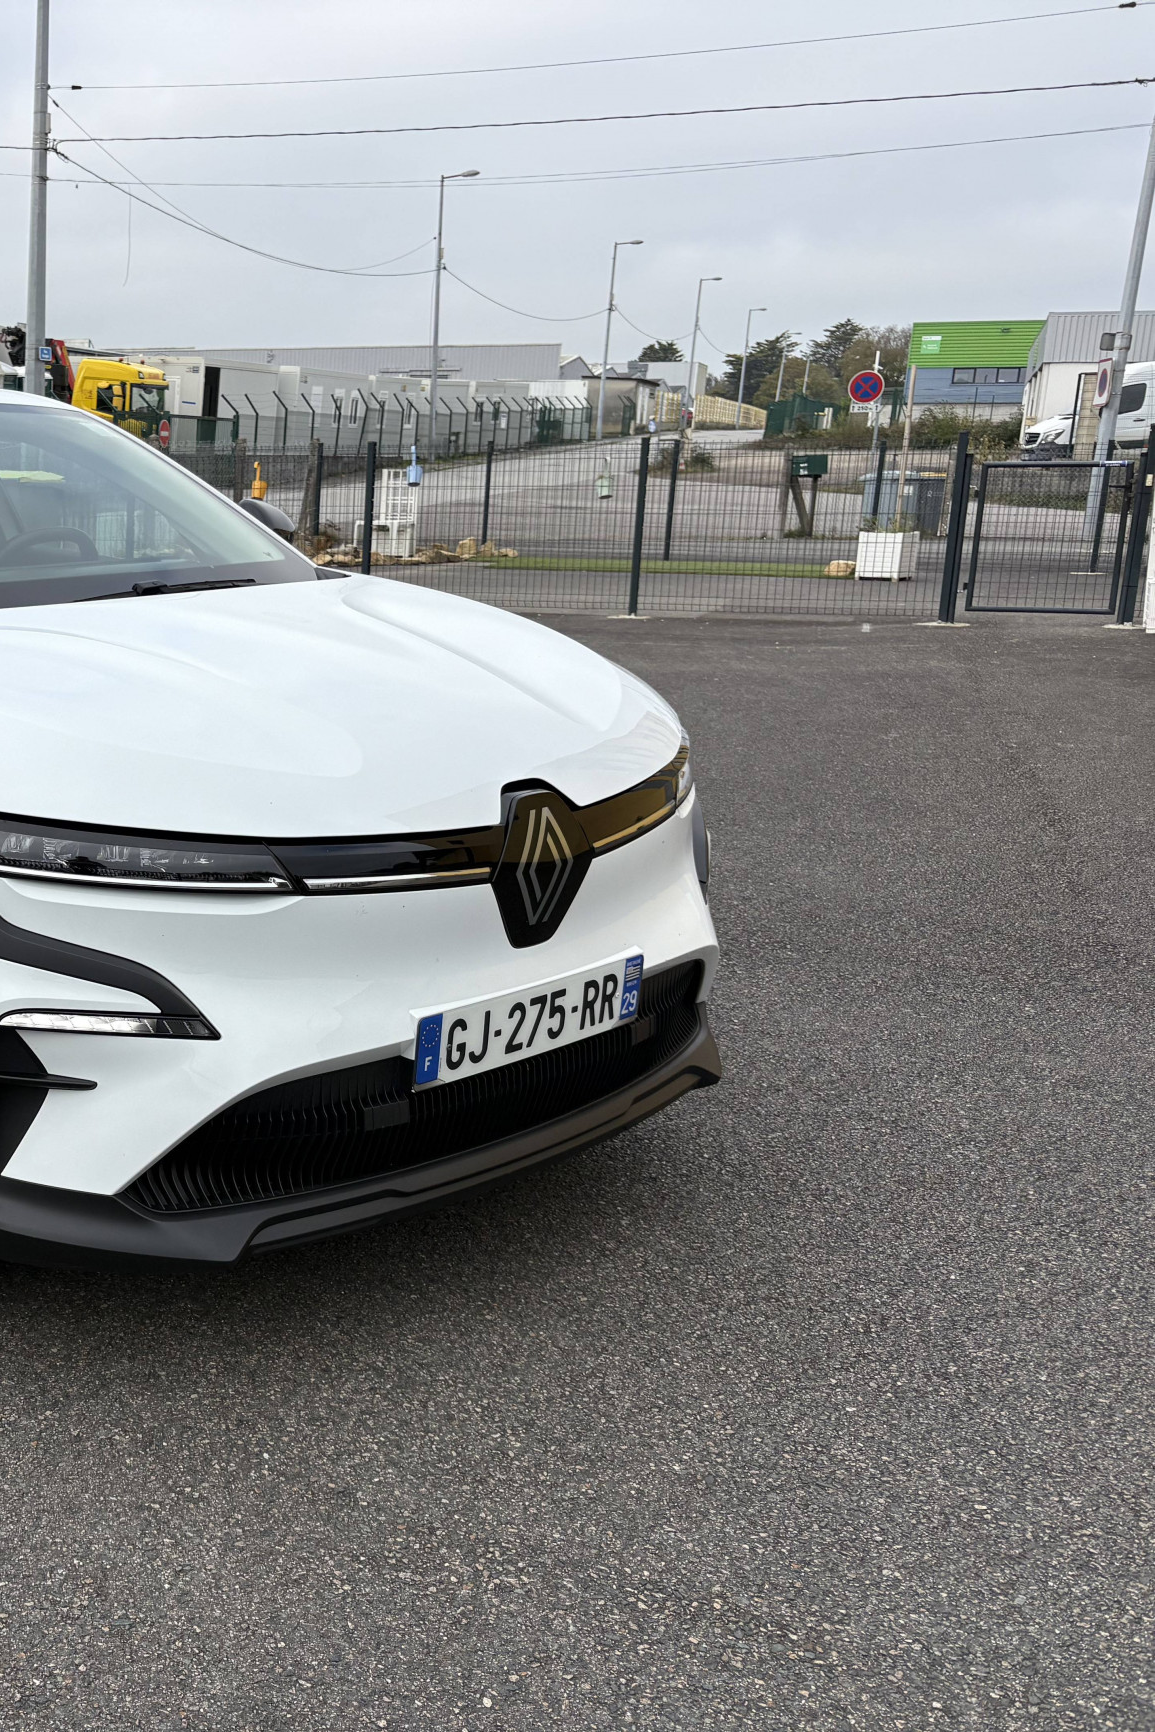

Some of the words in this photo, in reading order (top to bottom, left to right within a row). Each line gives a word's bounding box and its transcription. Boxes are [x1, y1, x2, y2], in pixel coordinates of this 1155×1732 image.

[621, 990, 637, 1014] 29
[446, 973, 618, 1070] GJ-275-RR
[424, 1056, 432, 1071] F
